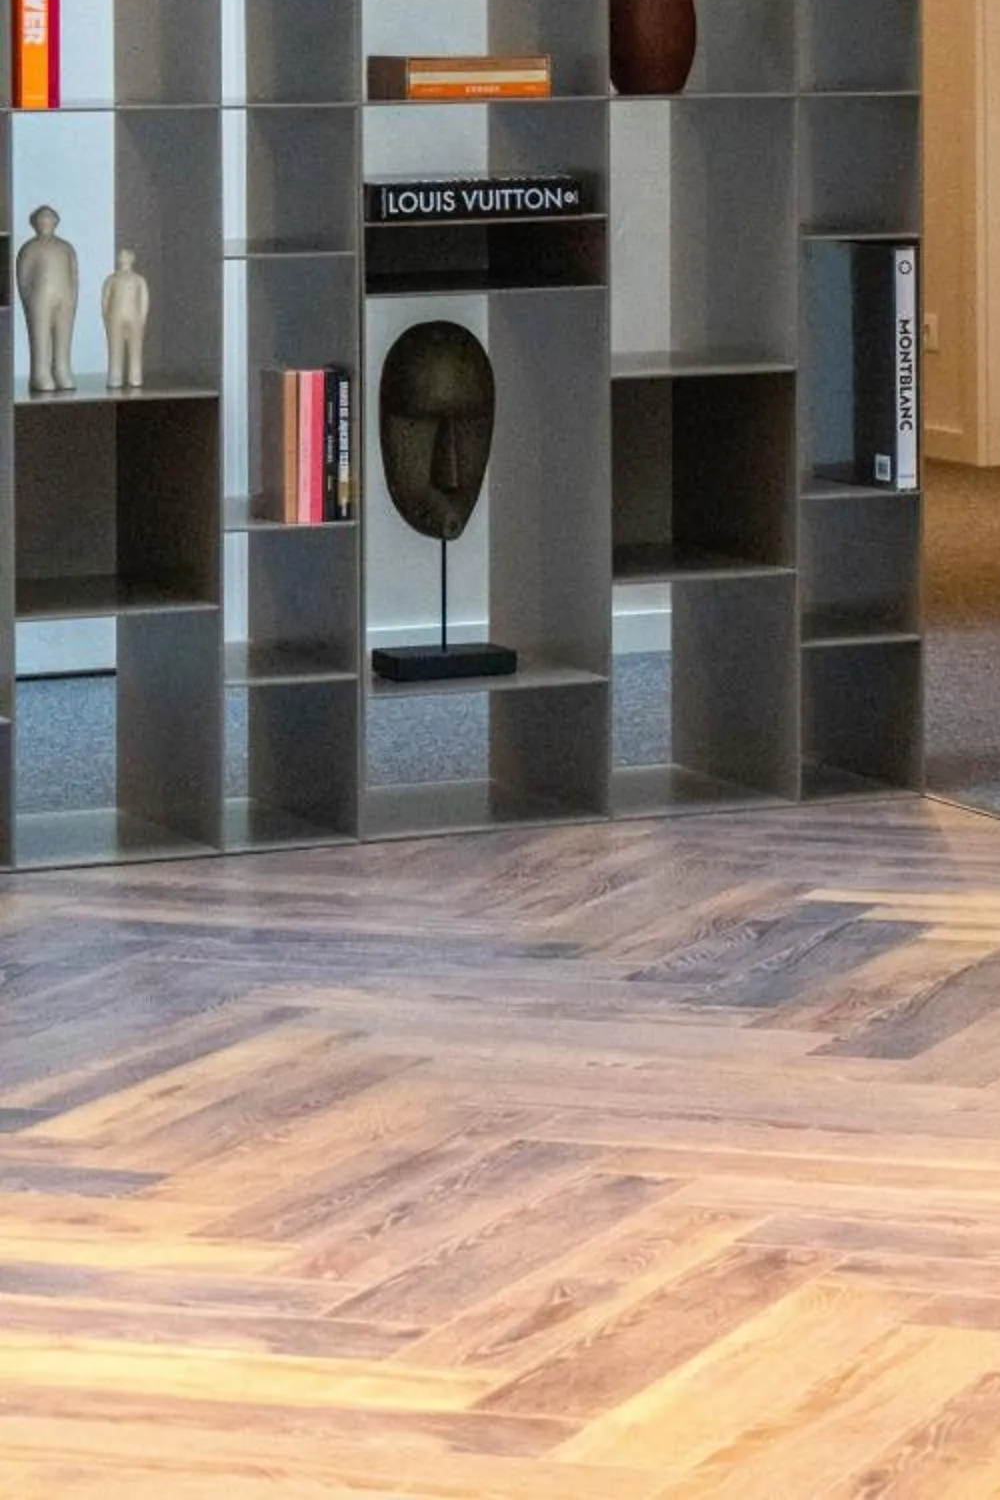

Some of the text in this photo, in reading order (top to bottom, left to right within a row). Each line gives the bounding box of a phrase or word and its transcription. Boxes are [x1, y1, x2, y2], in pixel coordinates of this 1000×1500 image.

[388, 187, 563, 214] LOUIS VUITTON
[898, 318, 913, 432] MONTBLANC
